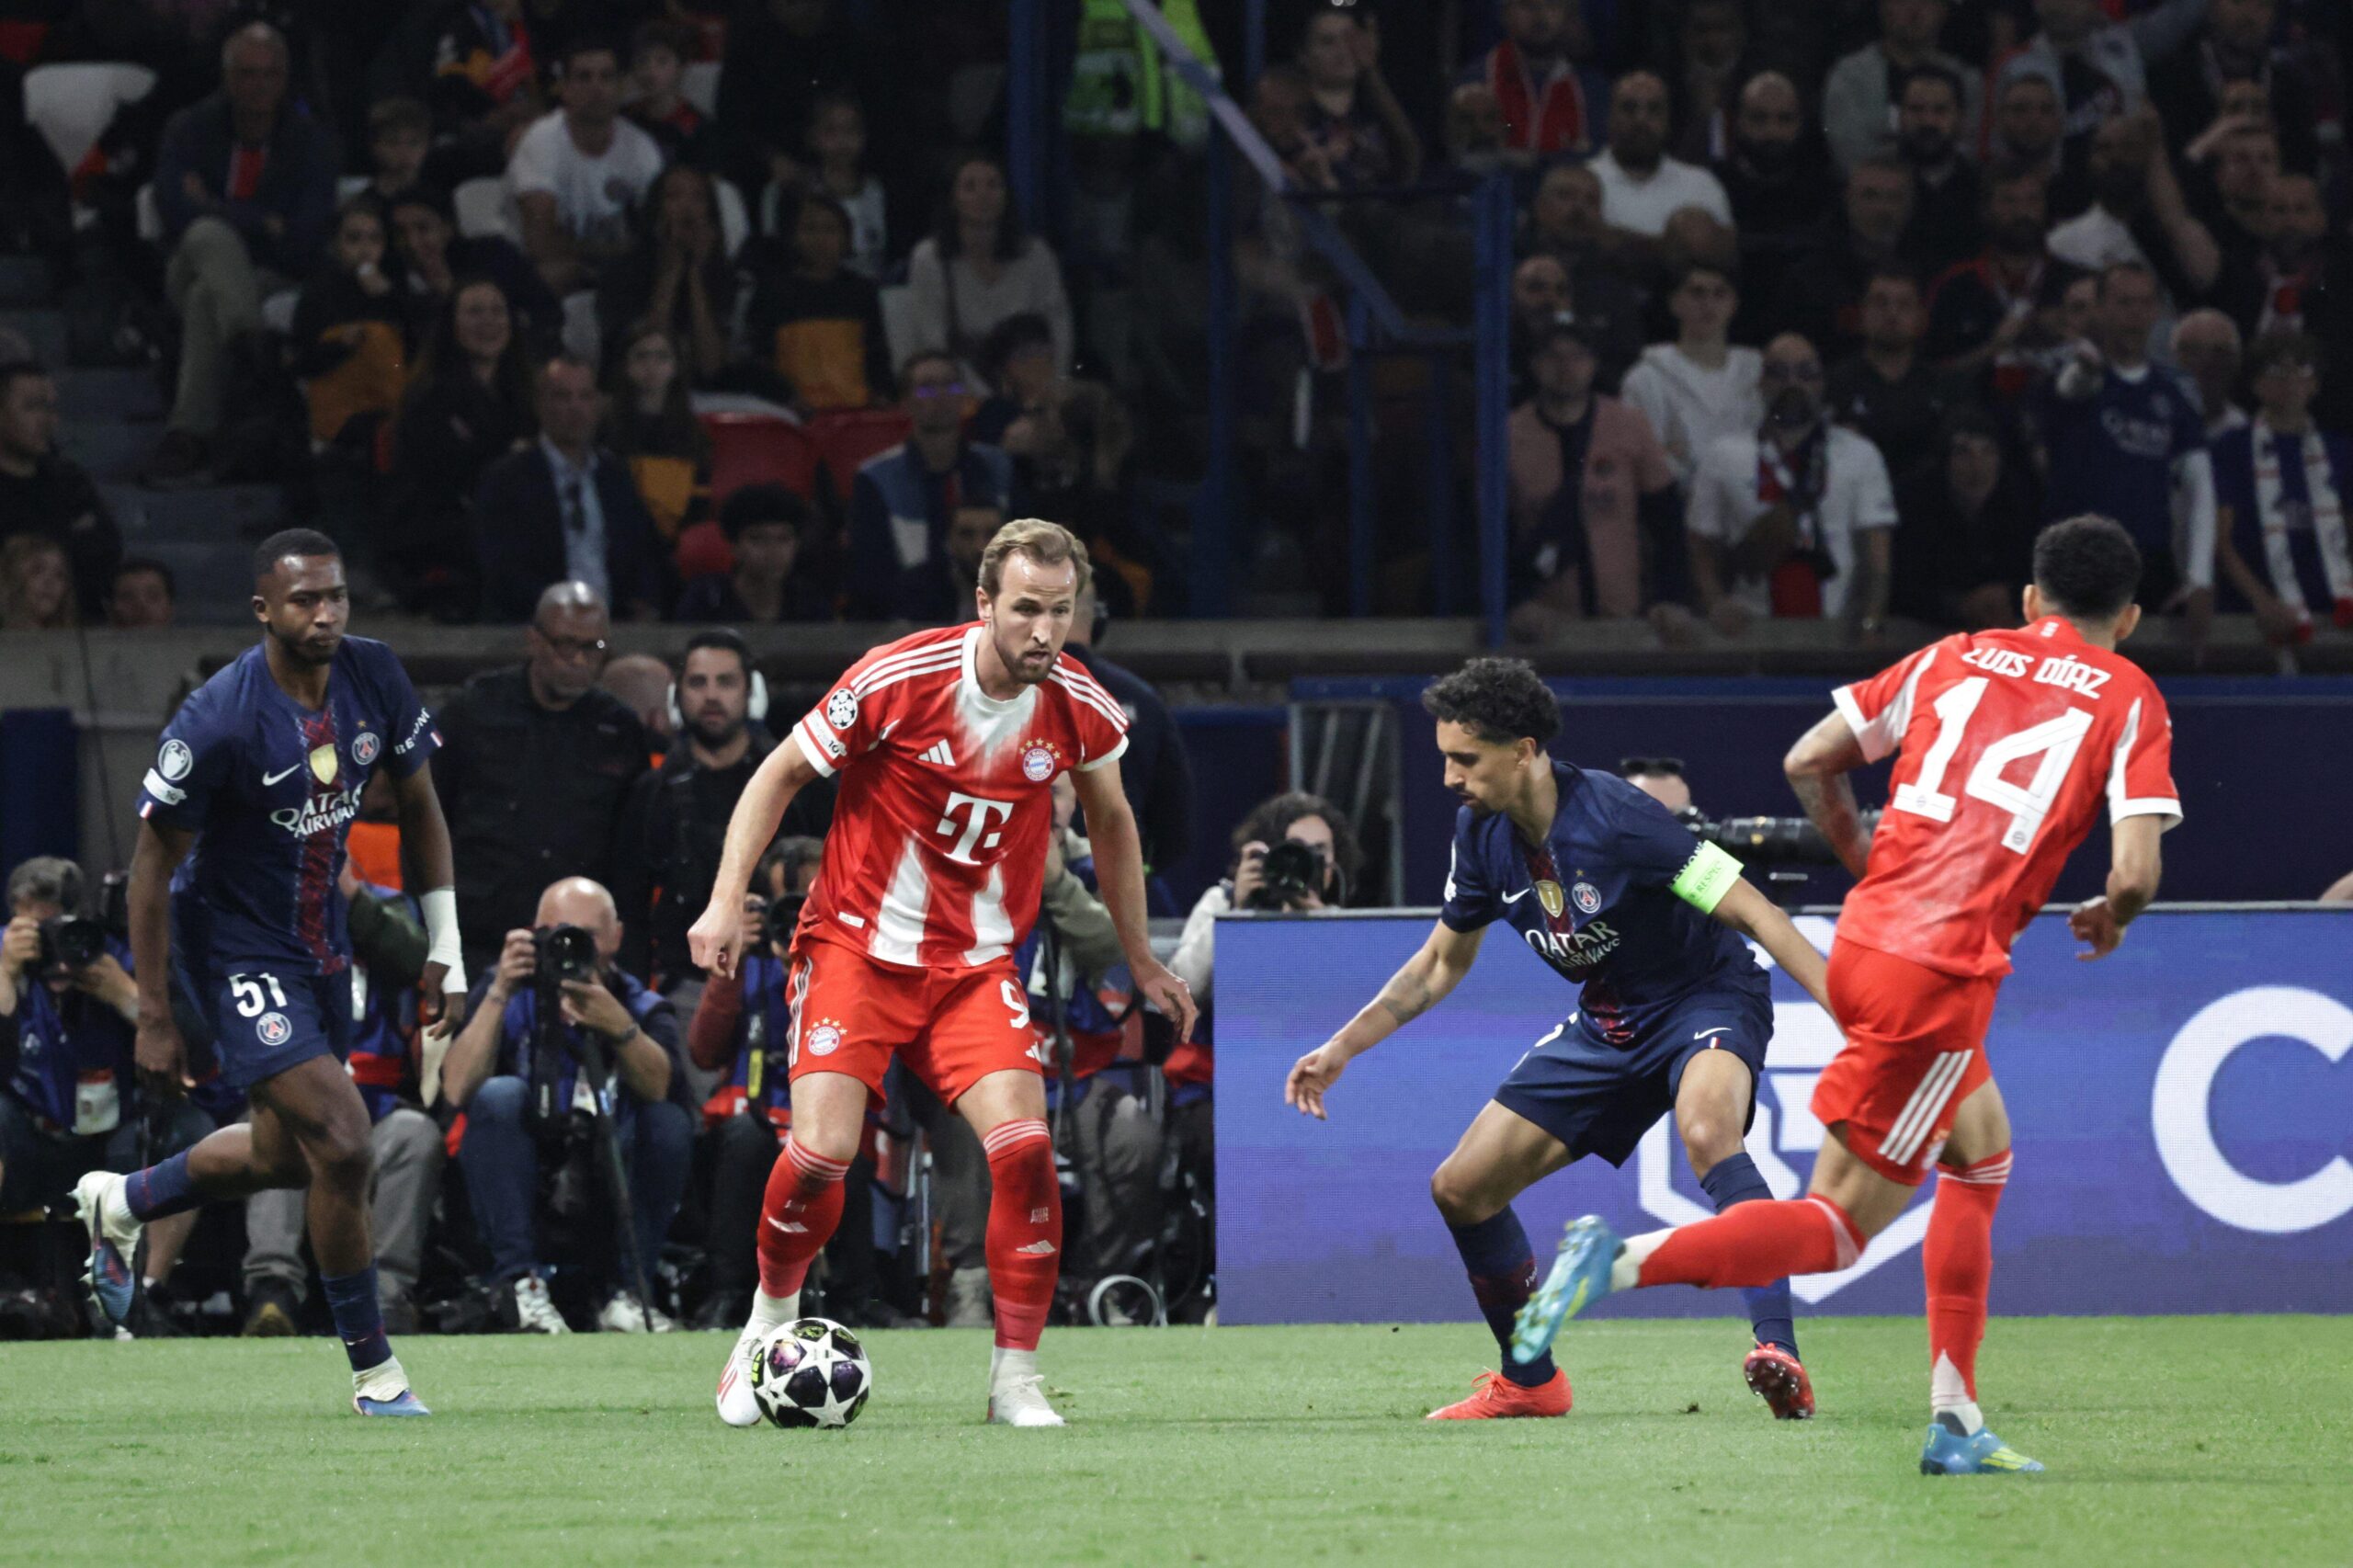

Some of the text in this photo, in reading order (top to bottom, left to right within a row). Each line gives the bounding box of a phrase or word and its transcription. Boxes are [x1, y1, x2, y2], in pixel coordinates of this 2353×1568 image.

[1961, 645, 2112, 699] LUIS DÍAZ
[1892, 676, 2095, 856] 14
[294, 805, 356, 838] AIRWA
[936, 791, 1014, 865] T
[1525, 921, 1620, 959] QATAR
[228, 971, 289, 1017] 51
[1000, 979, 1029, 1028] 9
